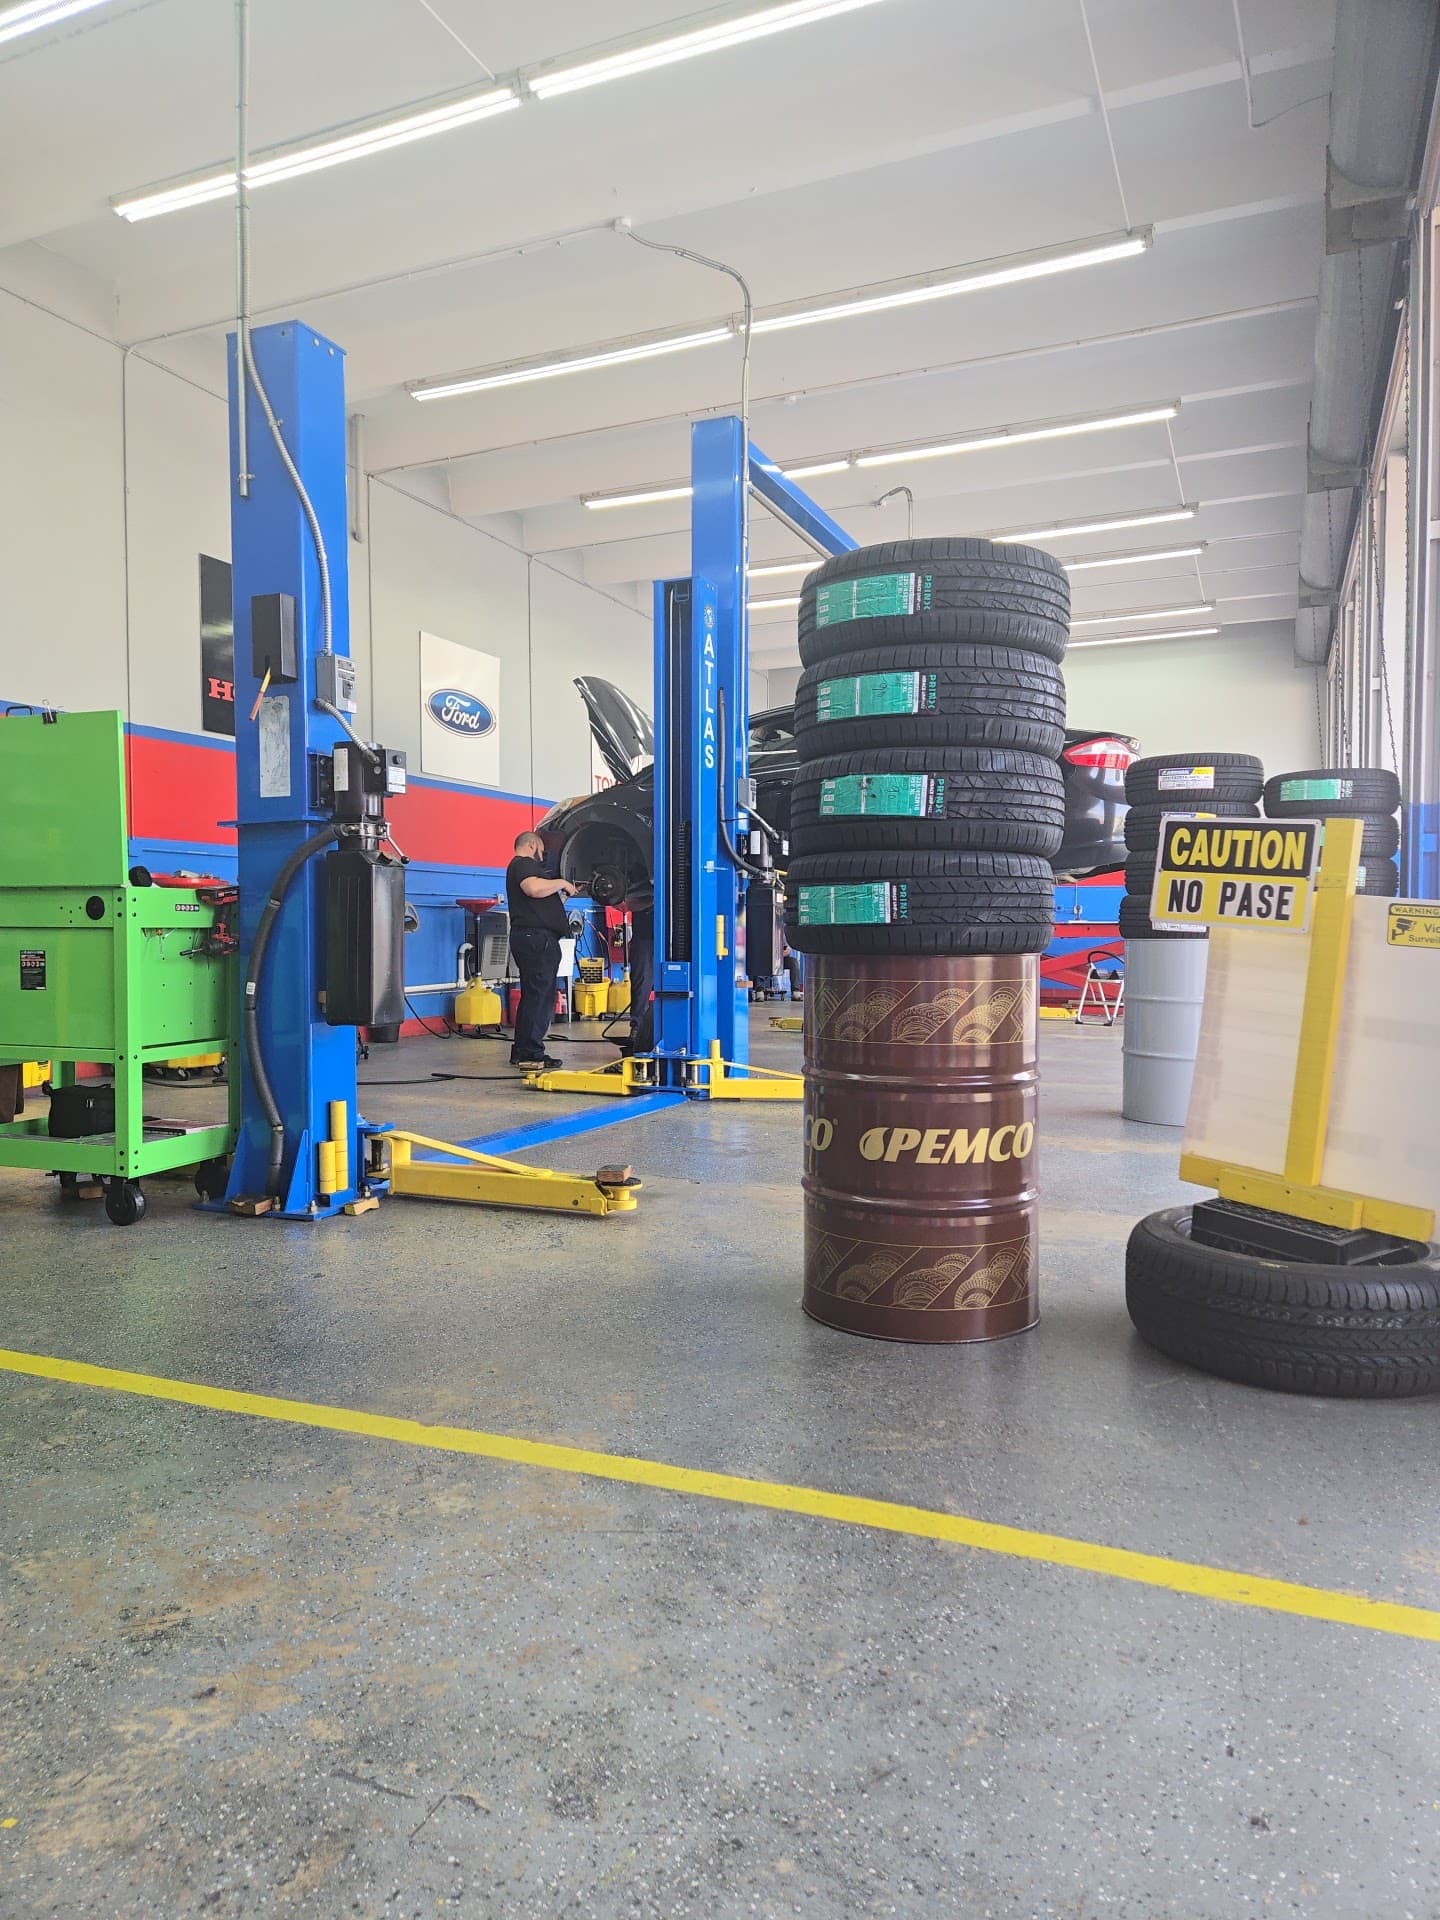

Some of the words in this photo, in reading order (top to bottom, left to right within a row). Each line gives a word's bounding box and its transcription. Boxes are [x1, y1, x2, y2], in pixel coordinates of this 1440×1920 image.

[923, 575, 933, 611] PRINX
[208, 678, 235, 702] H
[703, 633, 715, 769] ATLAS
[928, 674, 937, 710] PRINX
[441, 695, 480, 729] Ford
[935, 778, 945, 814] PRINX
[1170, 827, 1307, 870] CAUTION
[899, 884, 908, 919] PRINX
[1168, 879, 1203, 913] NO
[1218, 881, 1294, 921] PASE
[1394, 906, 1440, 916] WARNING
[883, 1121, 1034, 1164] PEMCO
